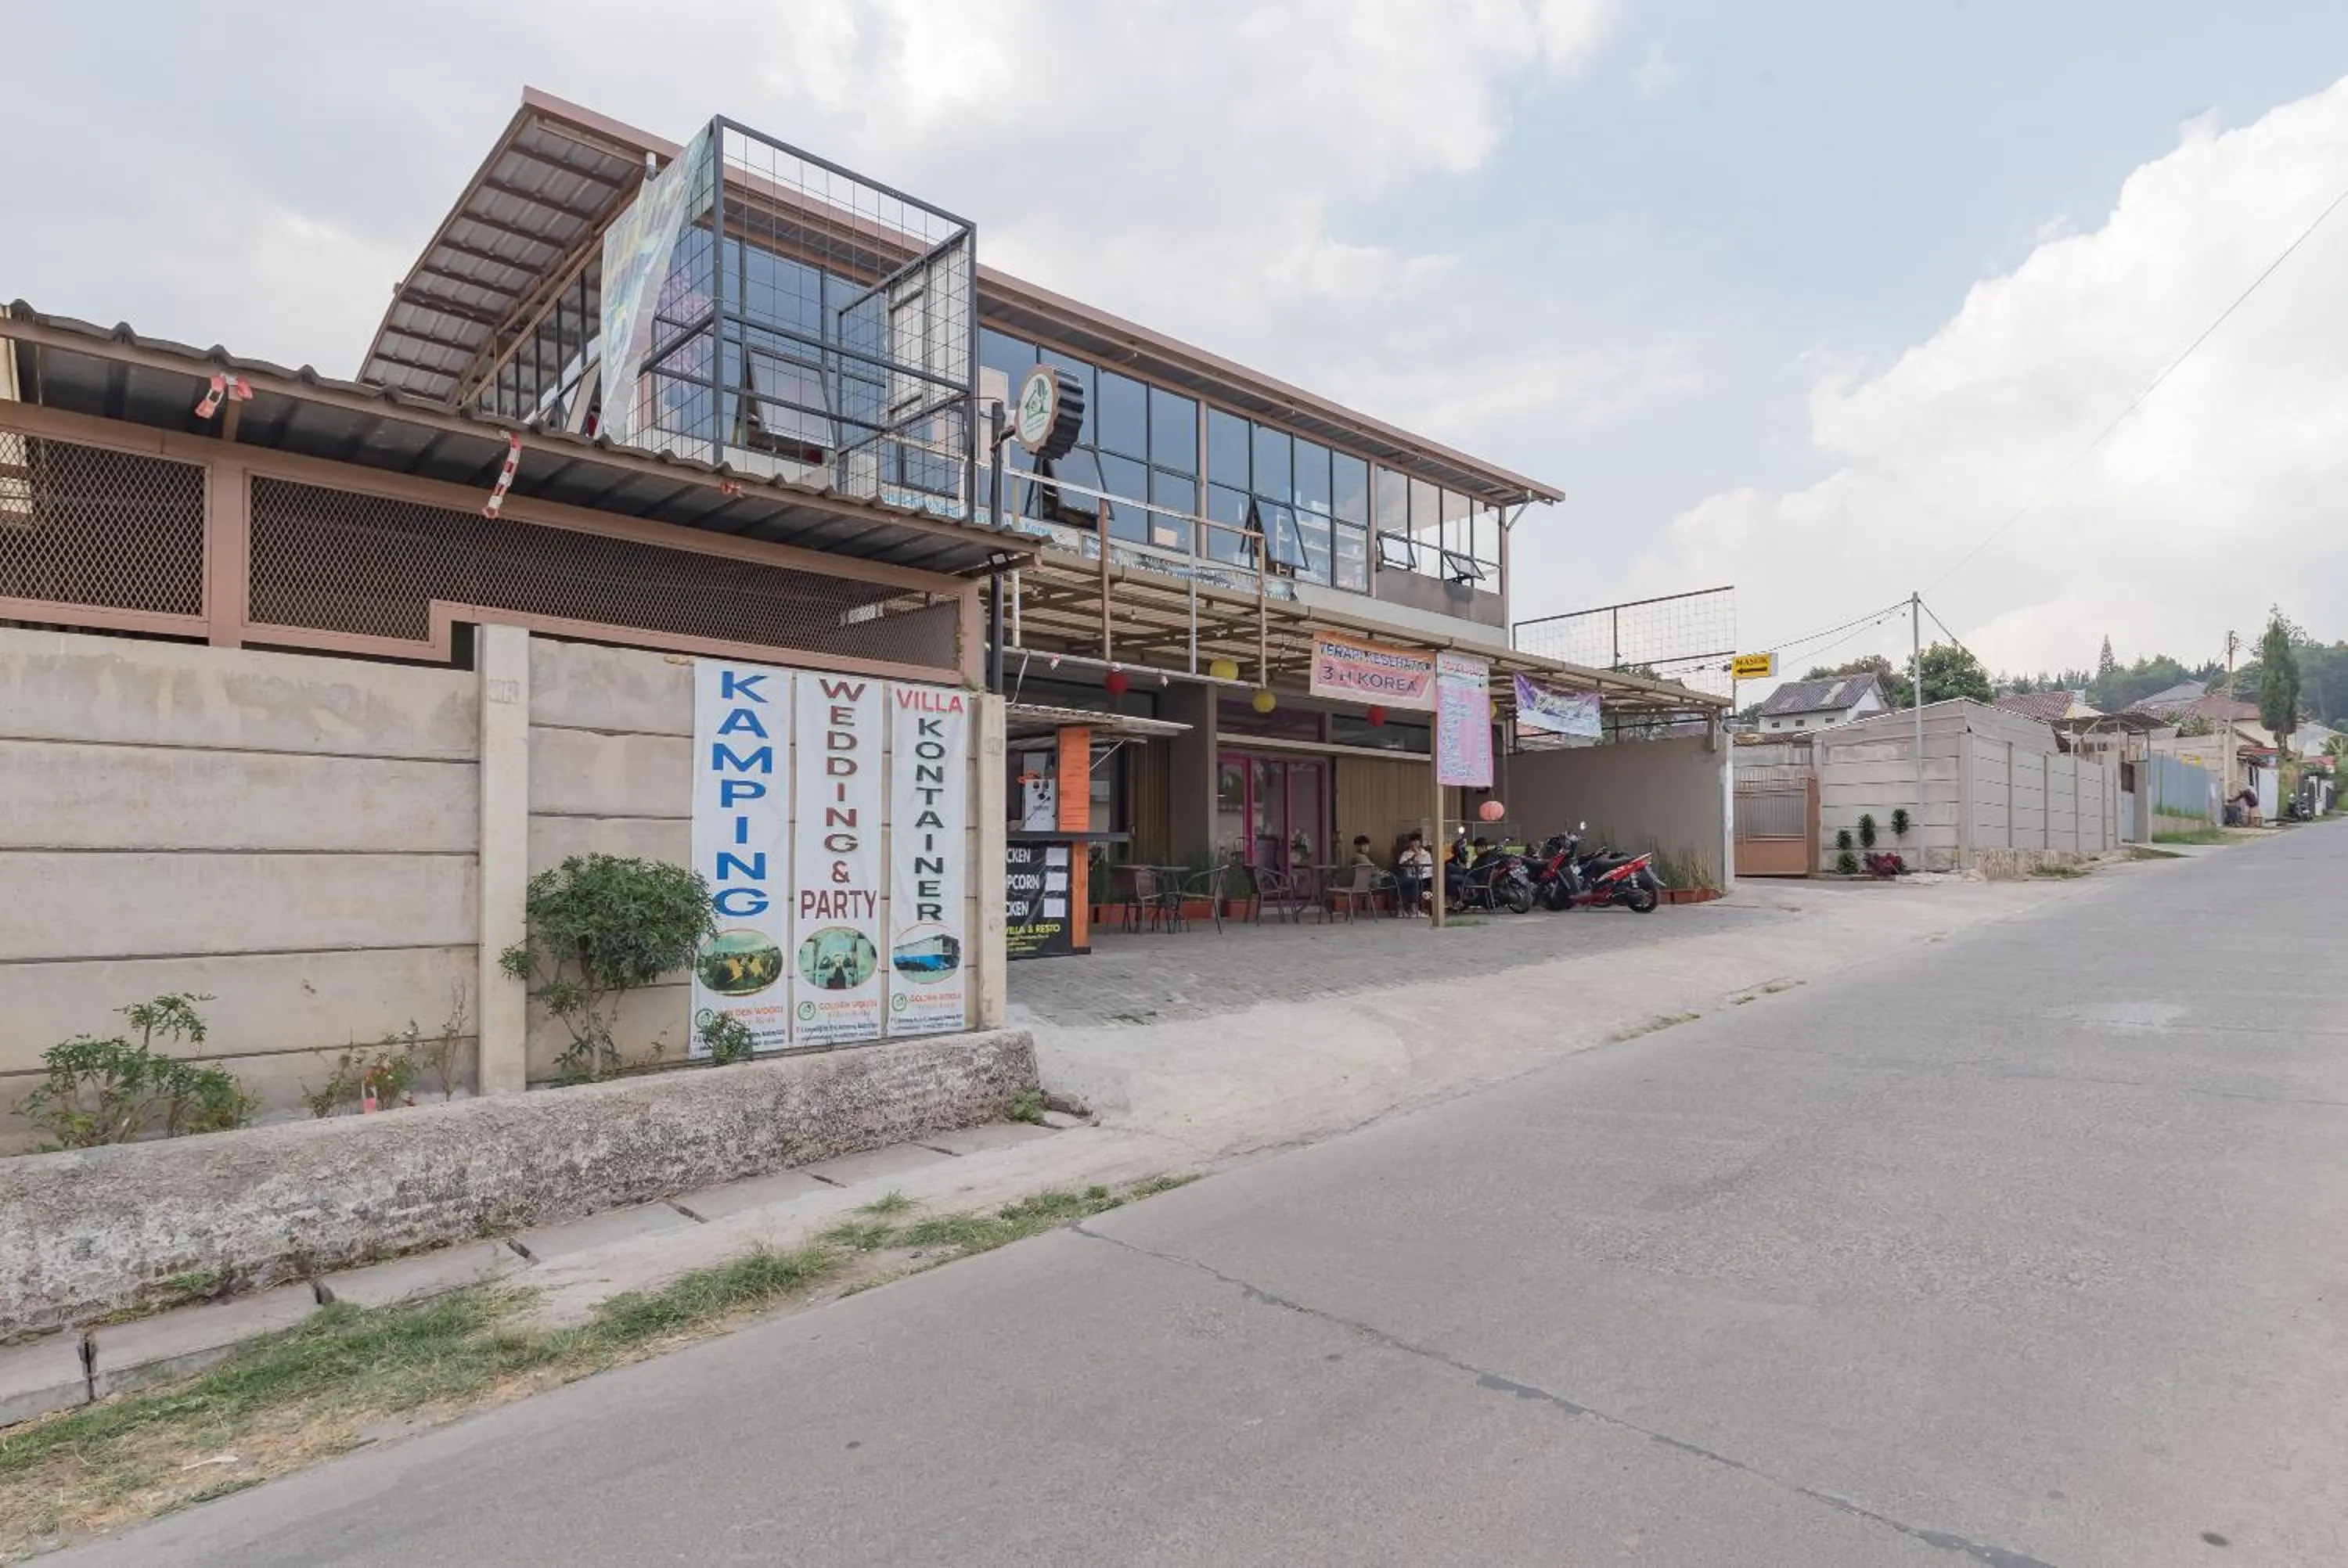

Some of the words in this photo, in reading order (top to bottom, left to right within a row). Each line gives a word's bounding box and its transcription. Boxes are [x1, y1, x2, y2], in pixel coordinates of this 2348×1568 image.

[1323, 666, 1334, 680] 3
[1358, 671, 1417, 692] KOREA
[896, 687, 963, 714] VILLA
[819, 678, 866, 853] WEDDING
[711, 671, 772, 916] KAMPING
[914, 717, 946, 921] KONTAINER
[1007, 847, 1031, 863] CKEN
[832, 860, 850, 883] &
[1007, 874, 1041, 890] PCORN
[800, 889, 877, 919] PARTY
